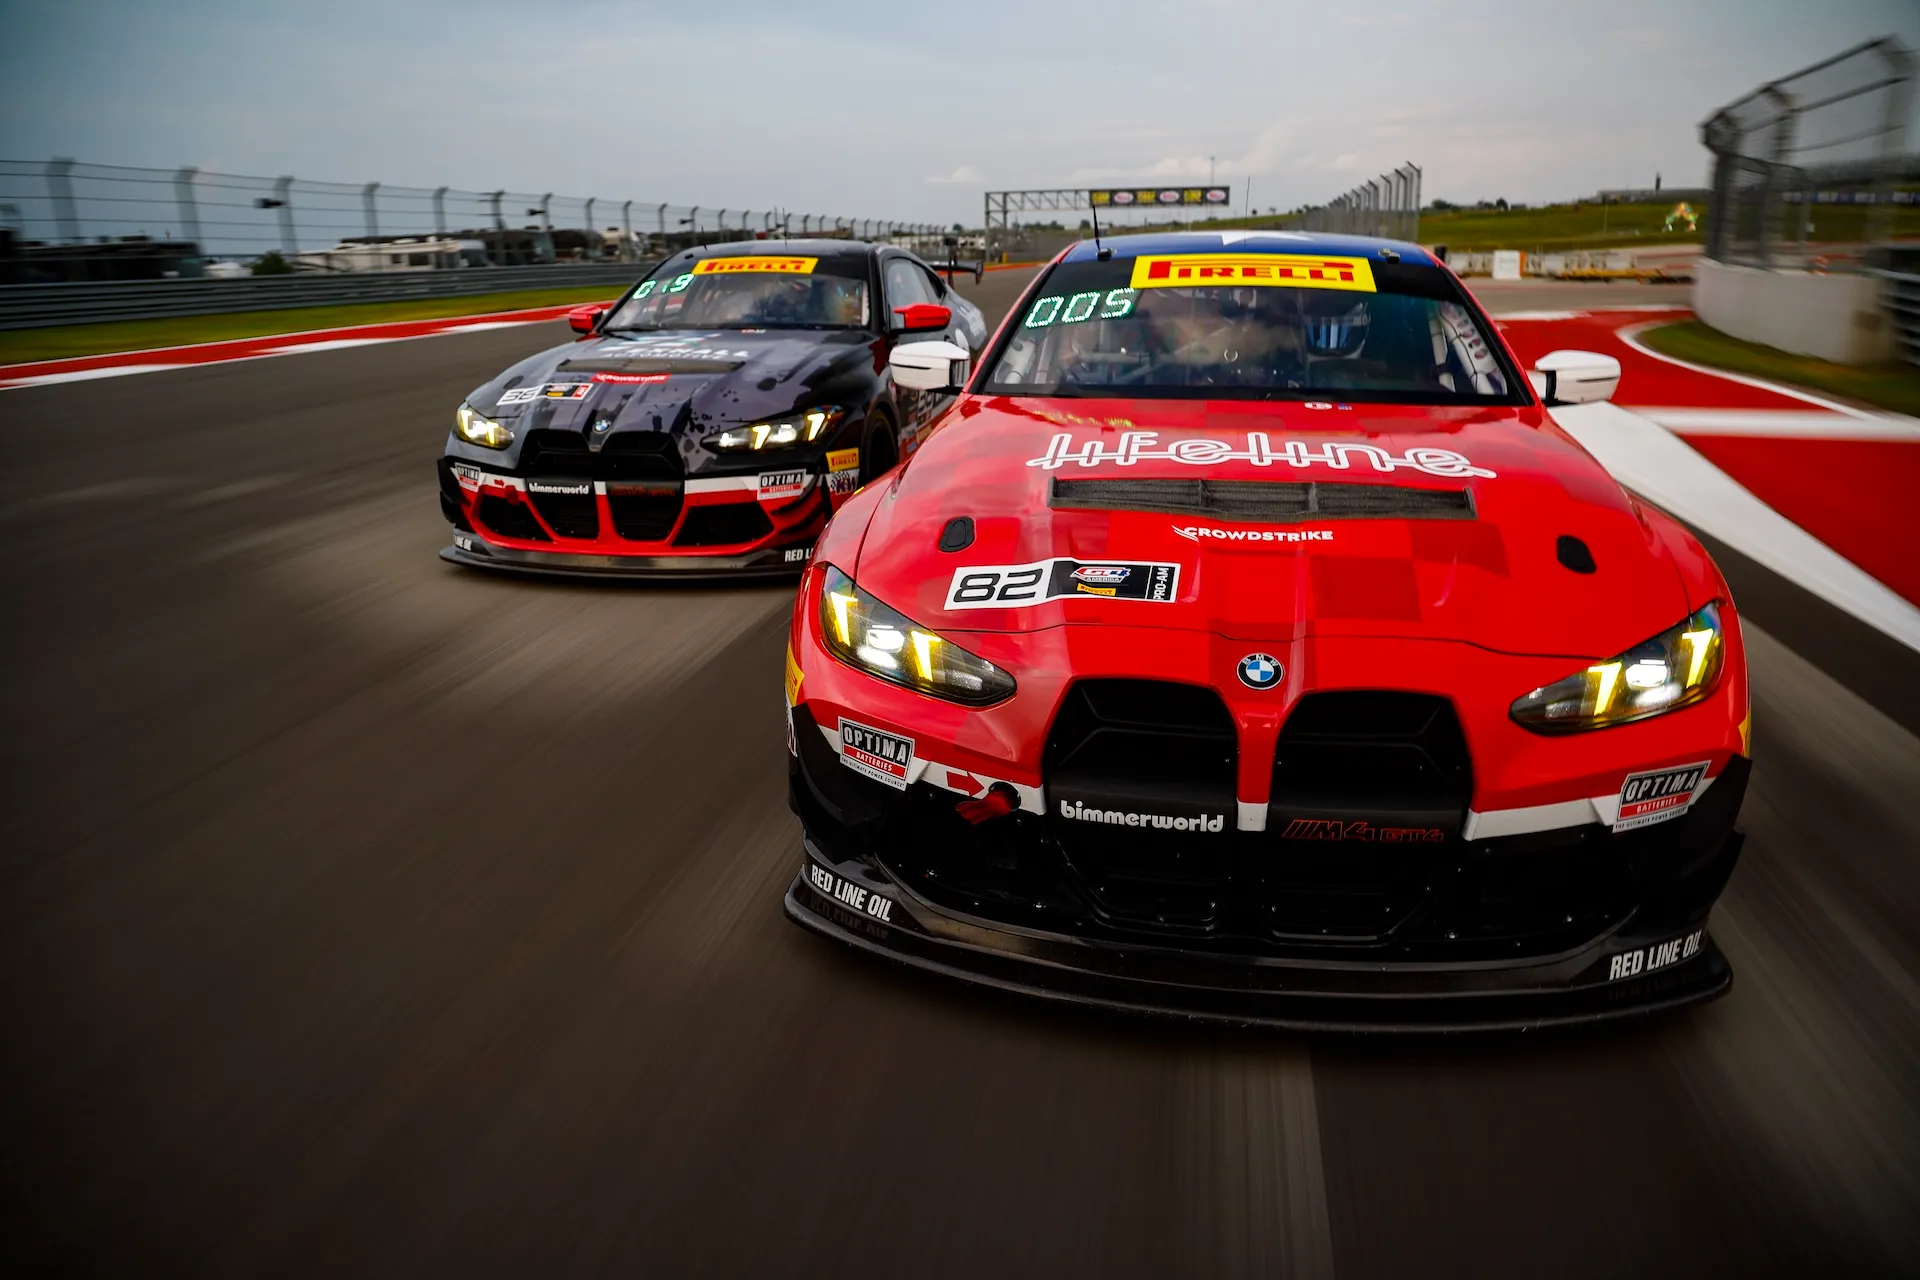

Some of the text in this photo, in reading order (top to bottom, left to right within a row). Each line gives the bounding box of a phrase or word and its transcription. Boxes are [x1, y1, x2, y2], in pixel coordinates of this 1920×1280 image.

[704, 260, 806, 272] PIRELLI
[1148, 261, 1354, 283] PIRELLI
[529, 482, 589, 495] bimmerworld
[762, 474, 802, 487] OPTIMA
[1180, 525, 1334, 542] CROWDSTRIKE
[785, 549, 803, 562] RED
[952, 568, 1044, 603] 82
[1153, 567, 1170, 601] PRO-AM
[843, 726, 907, 763] OPTIMA
[856, 751, 893, 772] BATTERIES
[1625, 771, 1699, 801] OPTIMA
[1636, 797, 1677, 814] BATTERIES
[1060, 800, 1223, 833] bimmerworld
[1379, 828, 1444, 843] GT4
[811, 864, 892, 922] RED LINE OIL
[1609, 949, 1644, 981] RED
[1646, 938, 1682, 971] LINE
